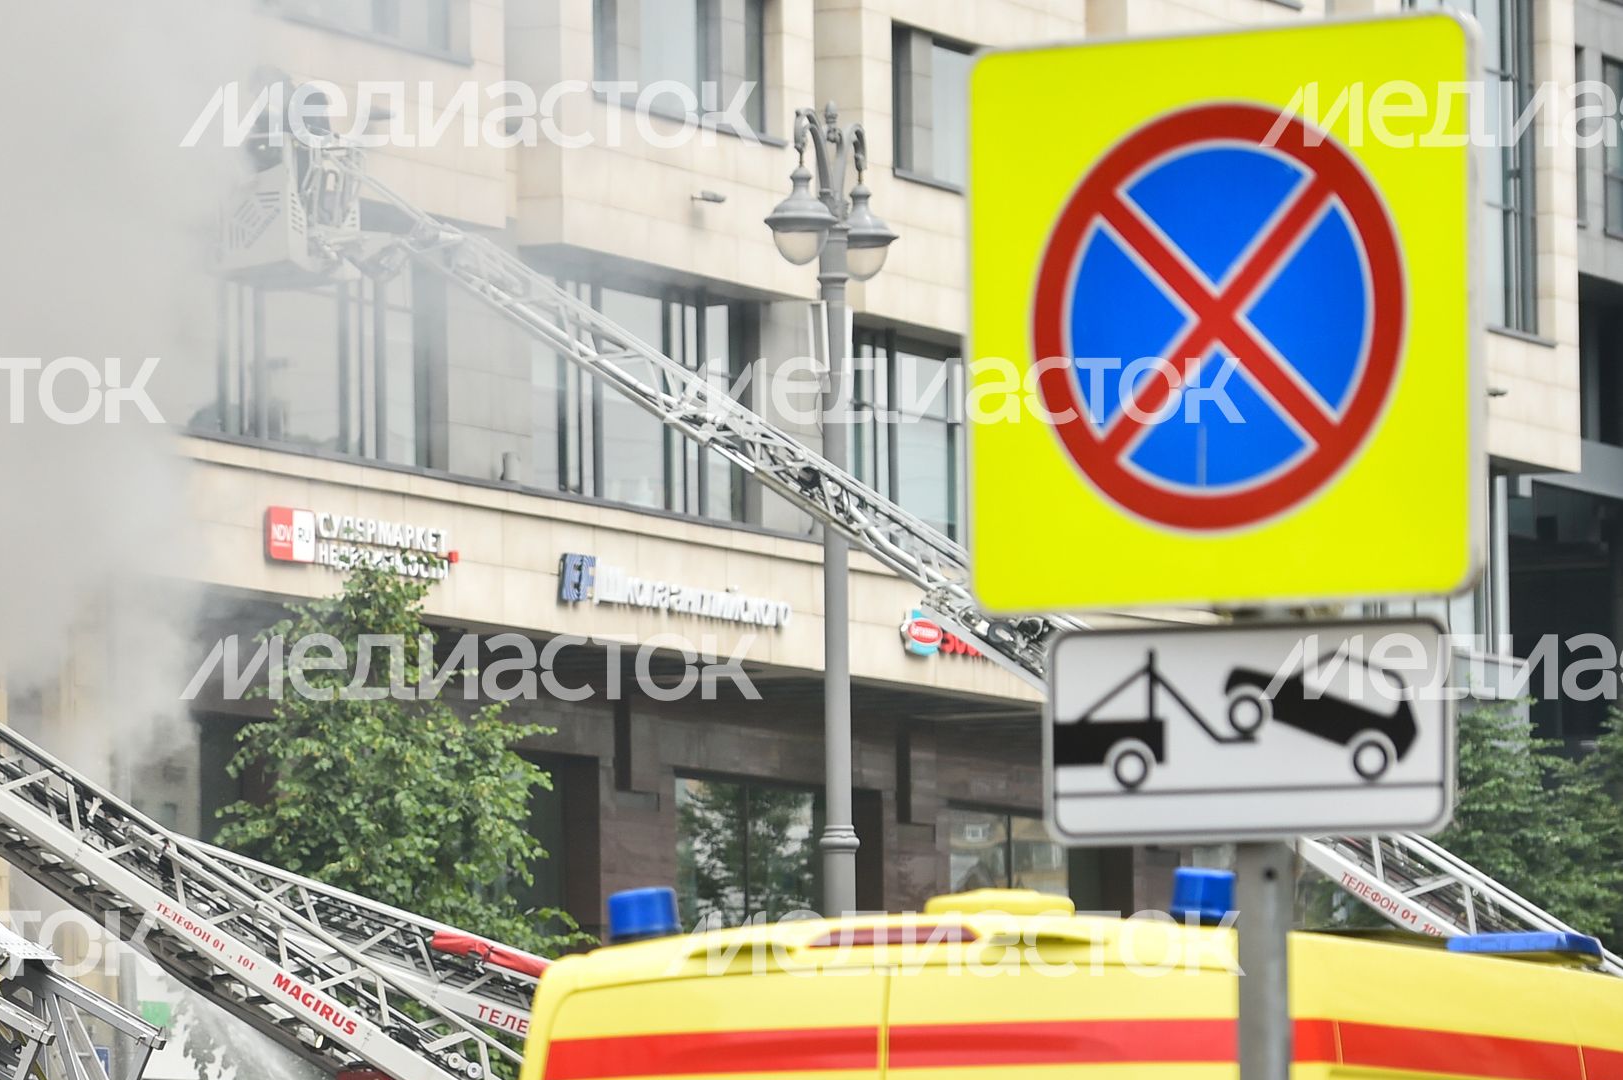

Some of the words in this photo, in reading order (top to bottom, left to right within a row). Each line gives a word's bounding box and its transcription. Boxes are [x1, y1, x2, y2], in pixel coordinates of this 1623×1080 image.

[318, 511, 448, 553] СУПЕРМАРКЕТ
[1340, 871, 1399, 915] ТЕЛЕФОН
[155, 901, 212, 943] ТЕЛЕФОН
[212, 937, 226, 952] 01
[236, 954, 257, 971] 101
[272, 972, 358, 1036] MAGIRUS
[478, 1003, 529, 1034] ТЕЛЕ
